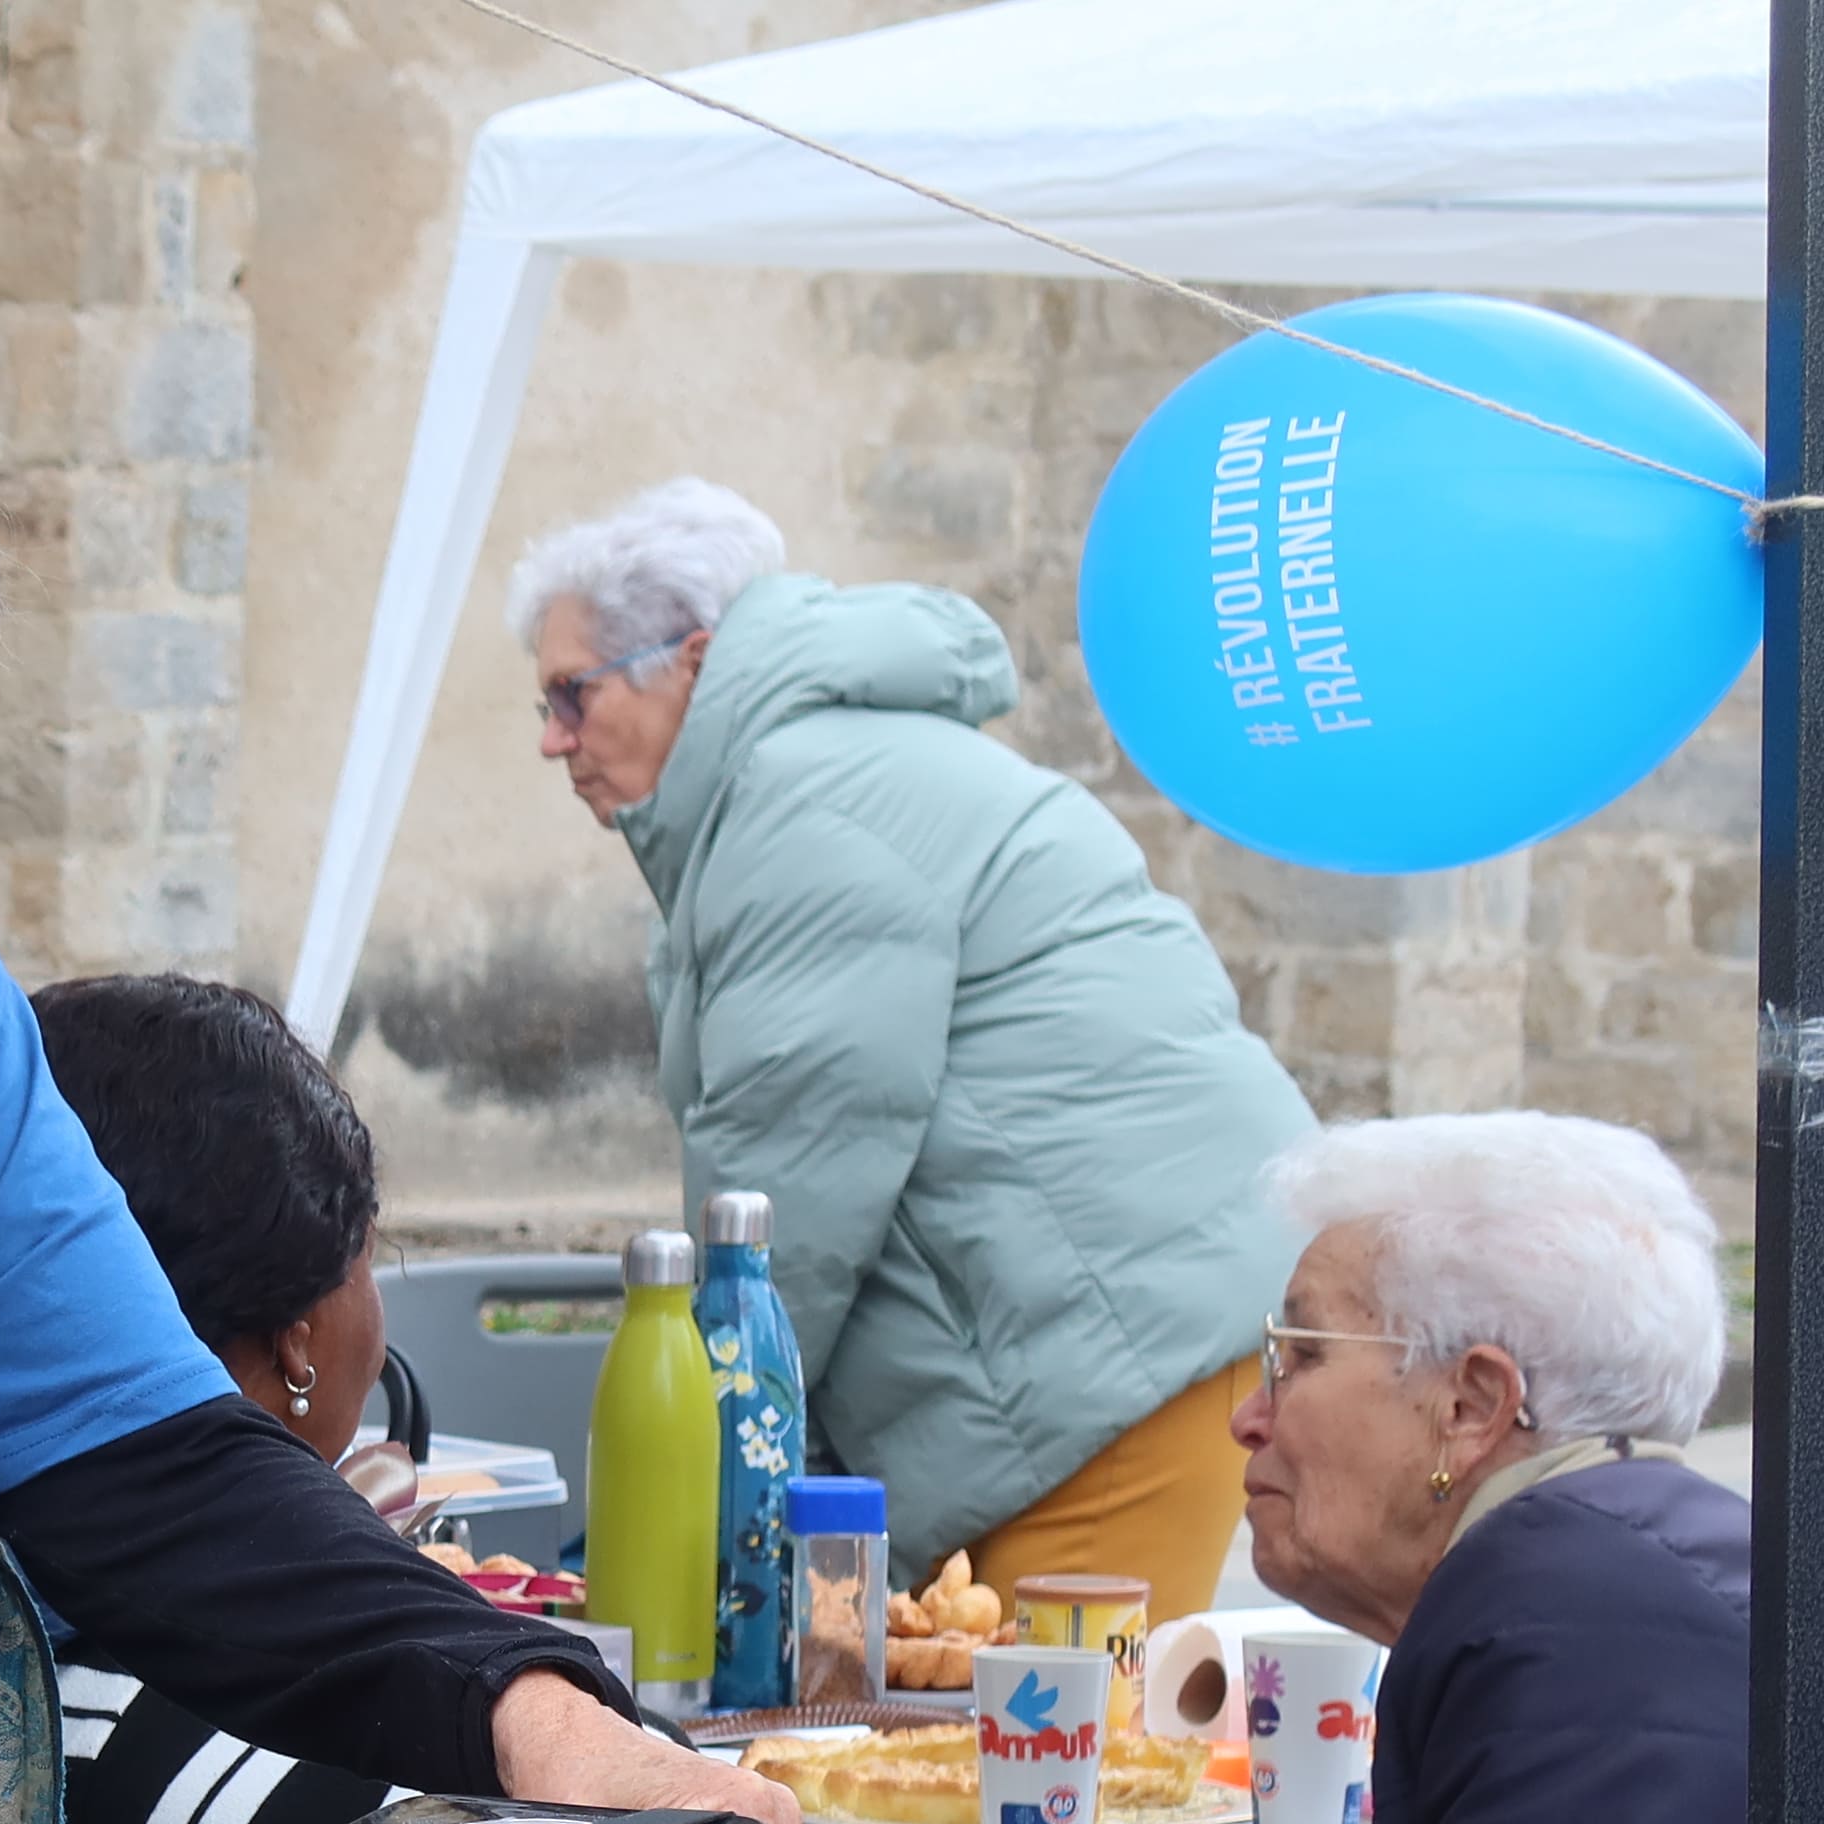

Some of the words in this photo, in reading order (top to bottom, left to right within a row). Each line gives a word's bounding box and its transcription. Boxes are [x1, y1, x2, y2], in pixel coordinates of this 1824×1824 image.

[1209, 415, 1285, 710] RÉVOLUTION
[1277, 409, 1374, 733] FRATERNELLE
[1244, 719, 1301, 748] #
